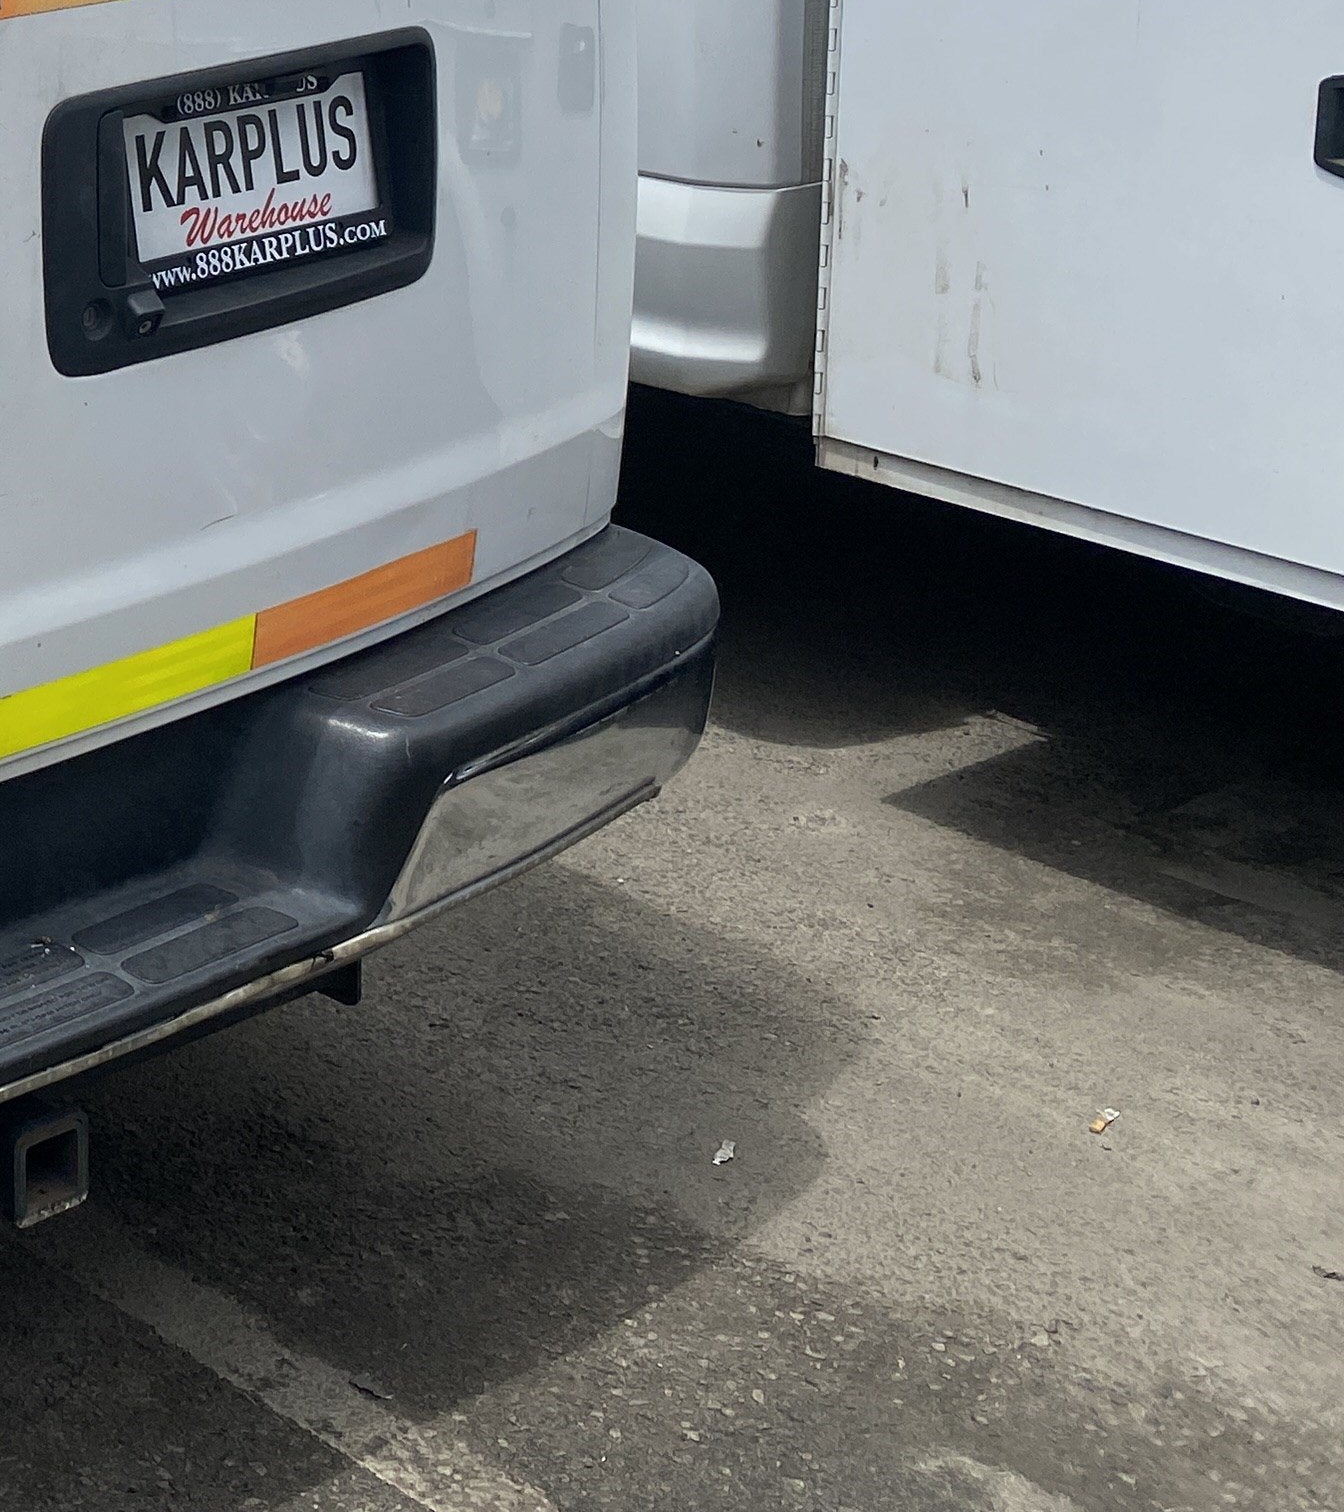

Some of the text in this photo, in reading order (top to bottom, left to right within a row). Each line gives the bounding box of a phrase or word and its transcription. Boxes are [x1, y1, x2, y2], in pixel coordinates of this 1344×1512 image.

[177, 89, 222, 115] (888)
[134, 94, 358, 213] KARPLUS
[179, 187, 333, 248] Warehouse
